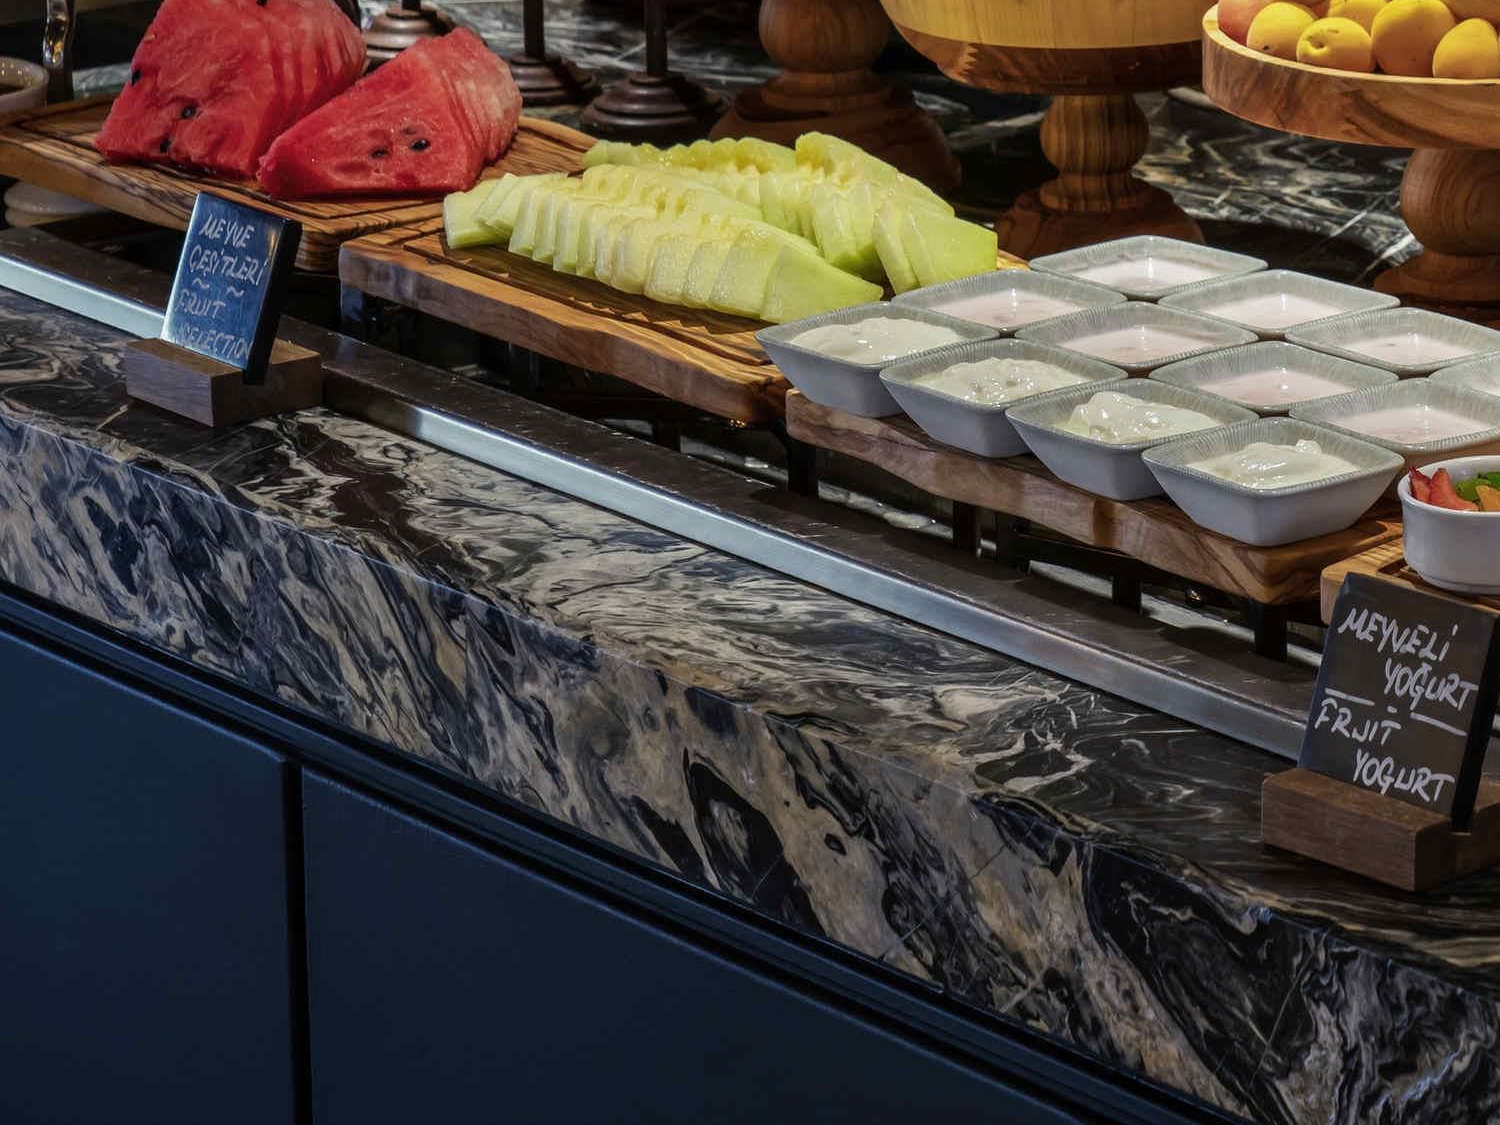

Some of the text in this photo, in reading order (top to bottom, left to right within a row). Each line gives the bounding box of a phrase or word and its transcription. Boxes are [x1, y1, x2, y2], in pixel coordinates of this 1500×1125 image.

[200, 213, 255, 248] MEYVE
[175, 289, 226, 319] FRUIT
[178, 323, 255, 361] SELECTION
[1384, 658, 1479, 711] YOĞURT
[1314, 698, 1401, 745] FRUIT
[1353, 748, 1455, 802] YOGURT
